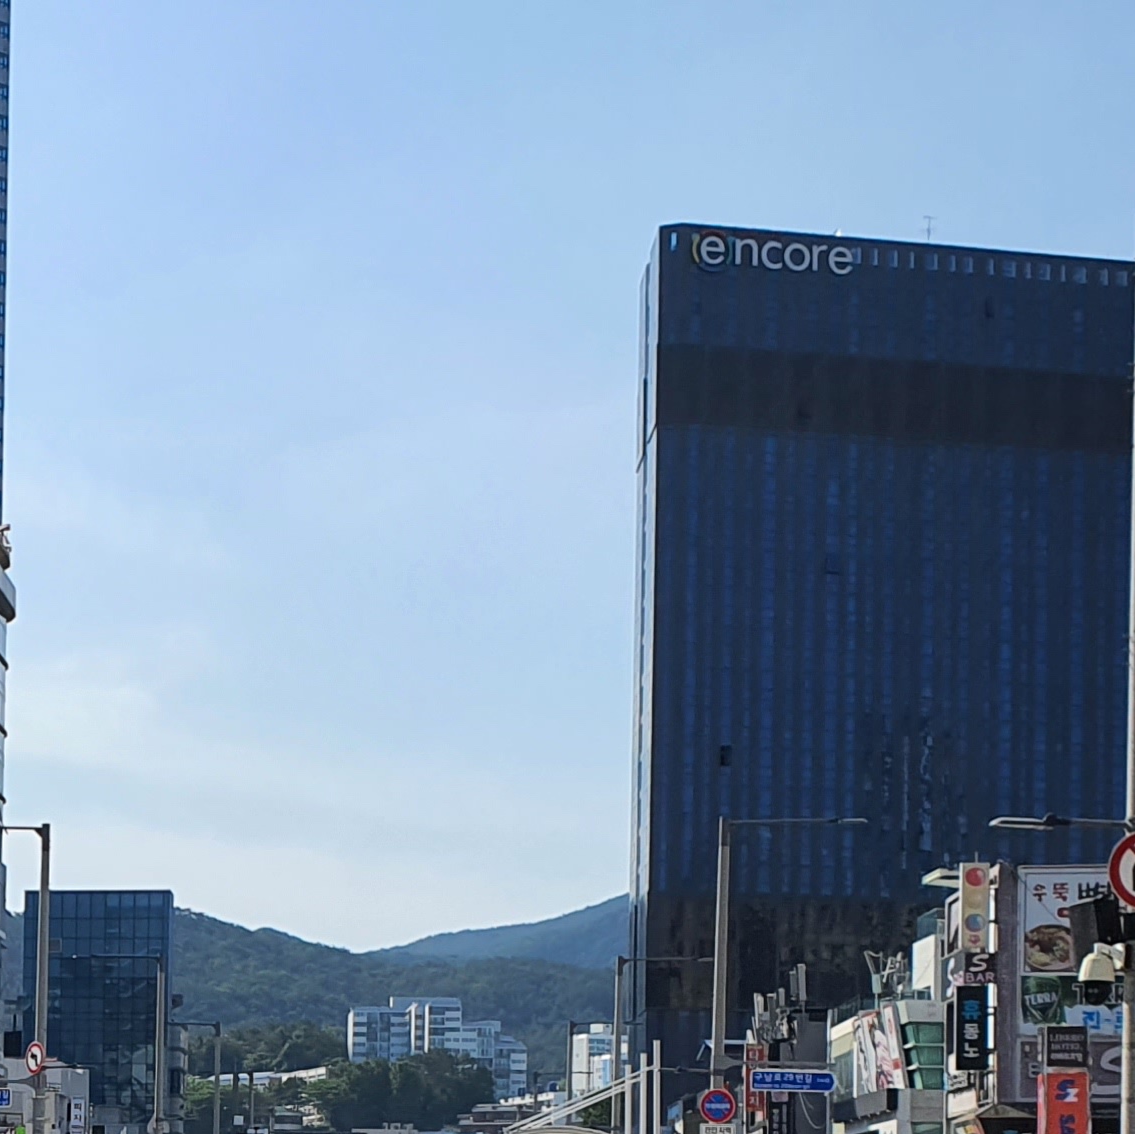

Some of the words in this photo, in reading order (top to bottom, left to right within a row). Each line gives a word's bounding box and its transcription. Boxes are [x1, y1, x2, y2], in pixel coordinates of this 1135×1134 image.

[698, 233, 854, 275] encore
[965, 972, 995, 983] BAR
[1023, 992, 1058, 1006] TERRA
